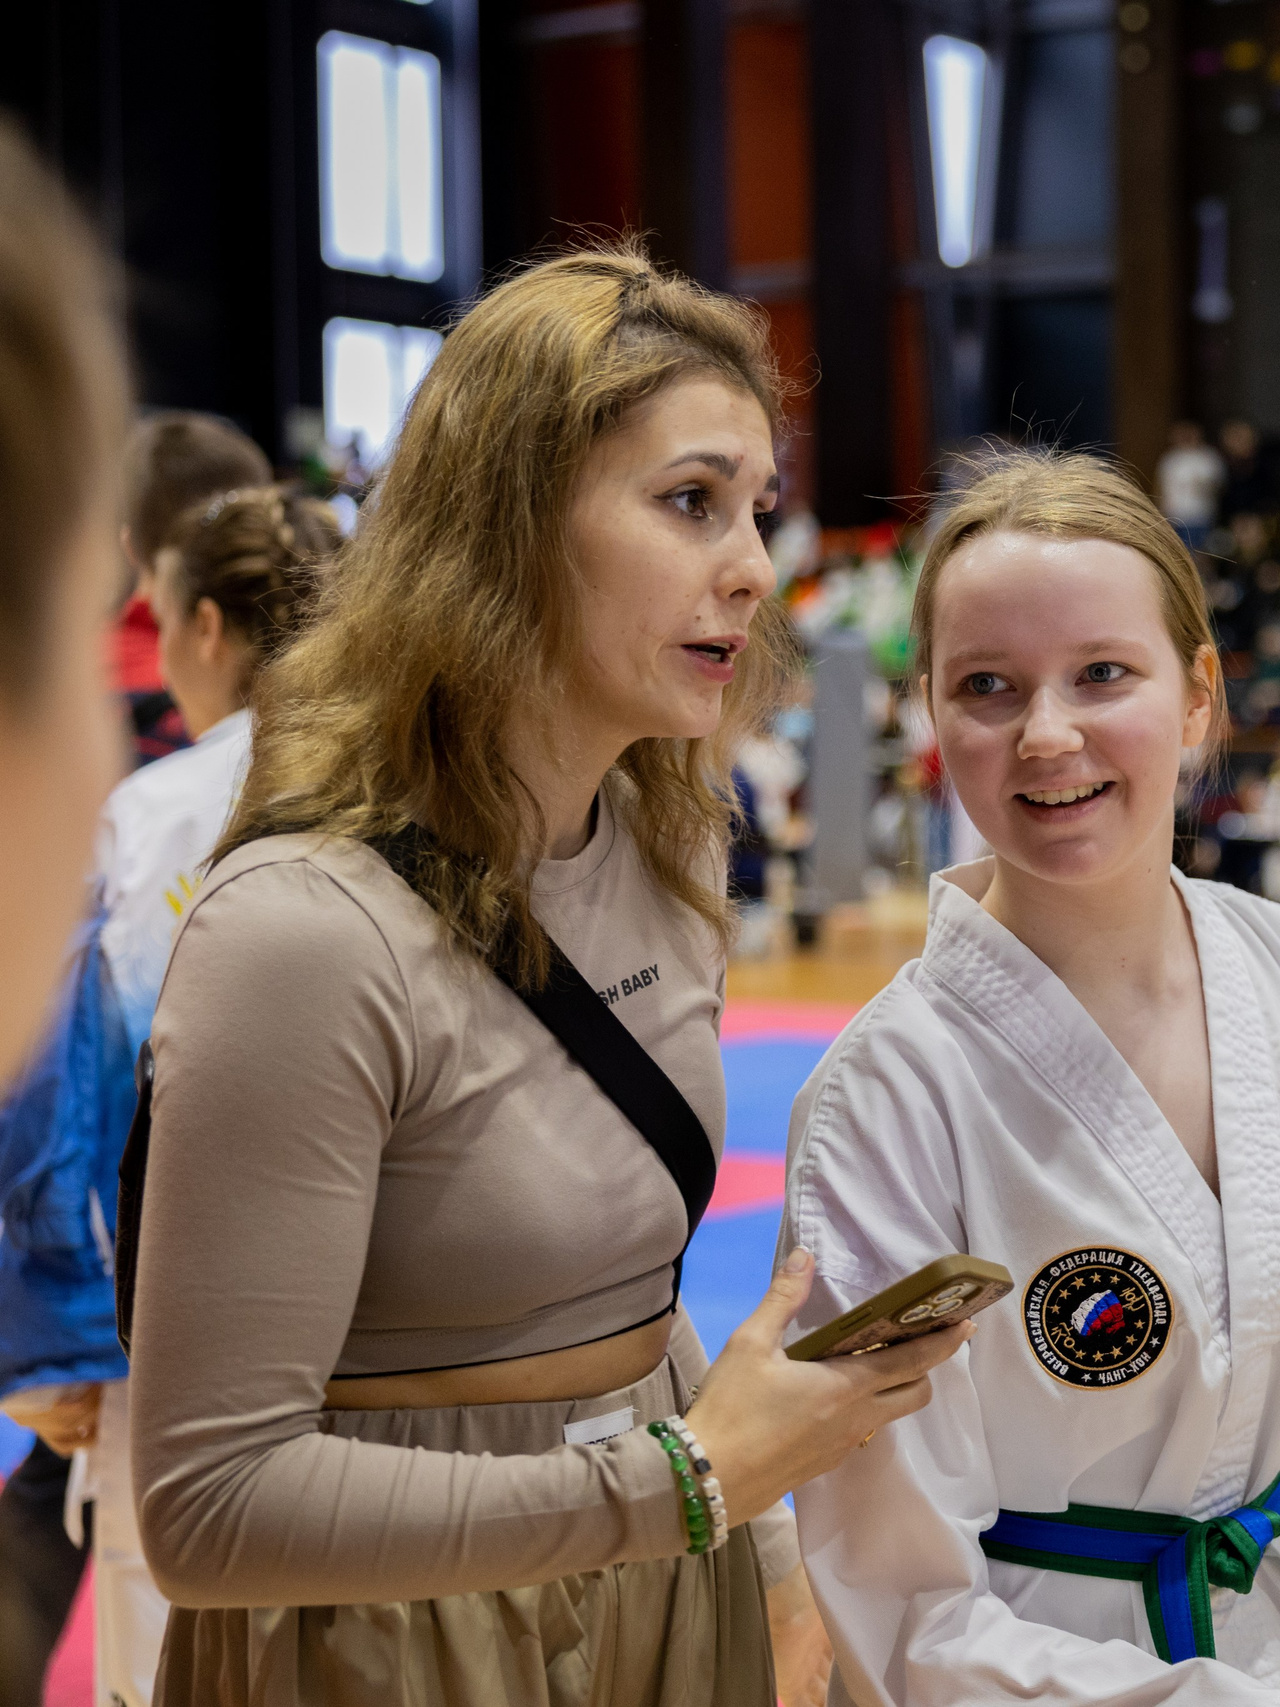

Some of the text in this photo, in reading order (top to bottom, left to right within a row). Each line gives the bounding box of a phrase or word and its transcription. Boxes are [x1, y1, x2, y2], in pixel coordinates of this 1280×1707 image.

[597, 963, 661, 1007] SH BABY
[1026, 1279, 1069, 1376] ВСЕРОССИЙСКАЯ
[1050, 1251, 1124, 1277] ФЕДЕРАЦИЯ
[1098, 1352, 1151, 1385] ЧАНГ-ХОН
